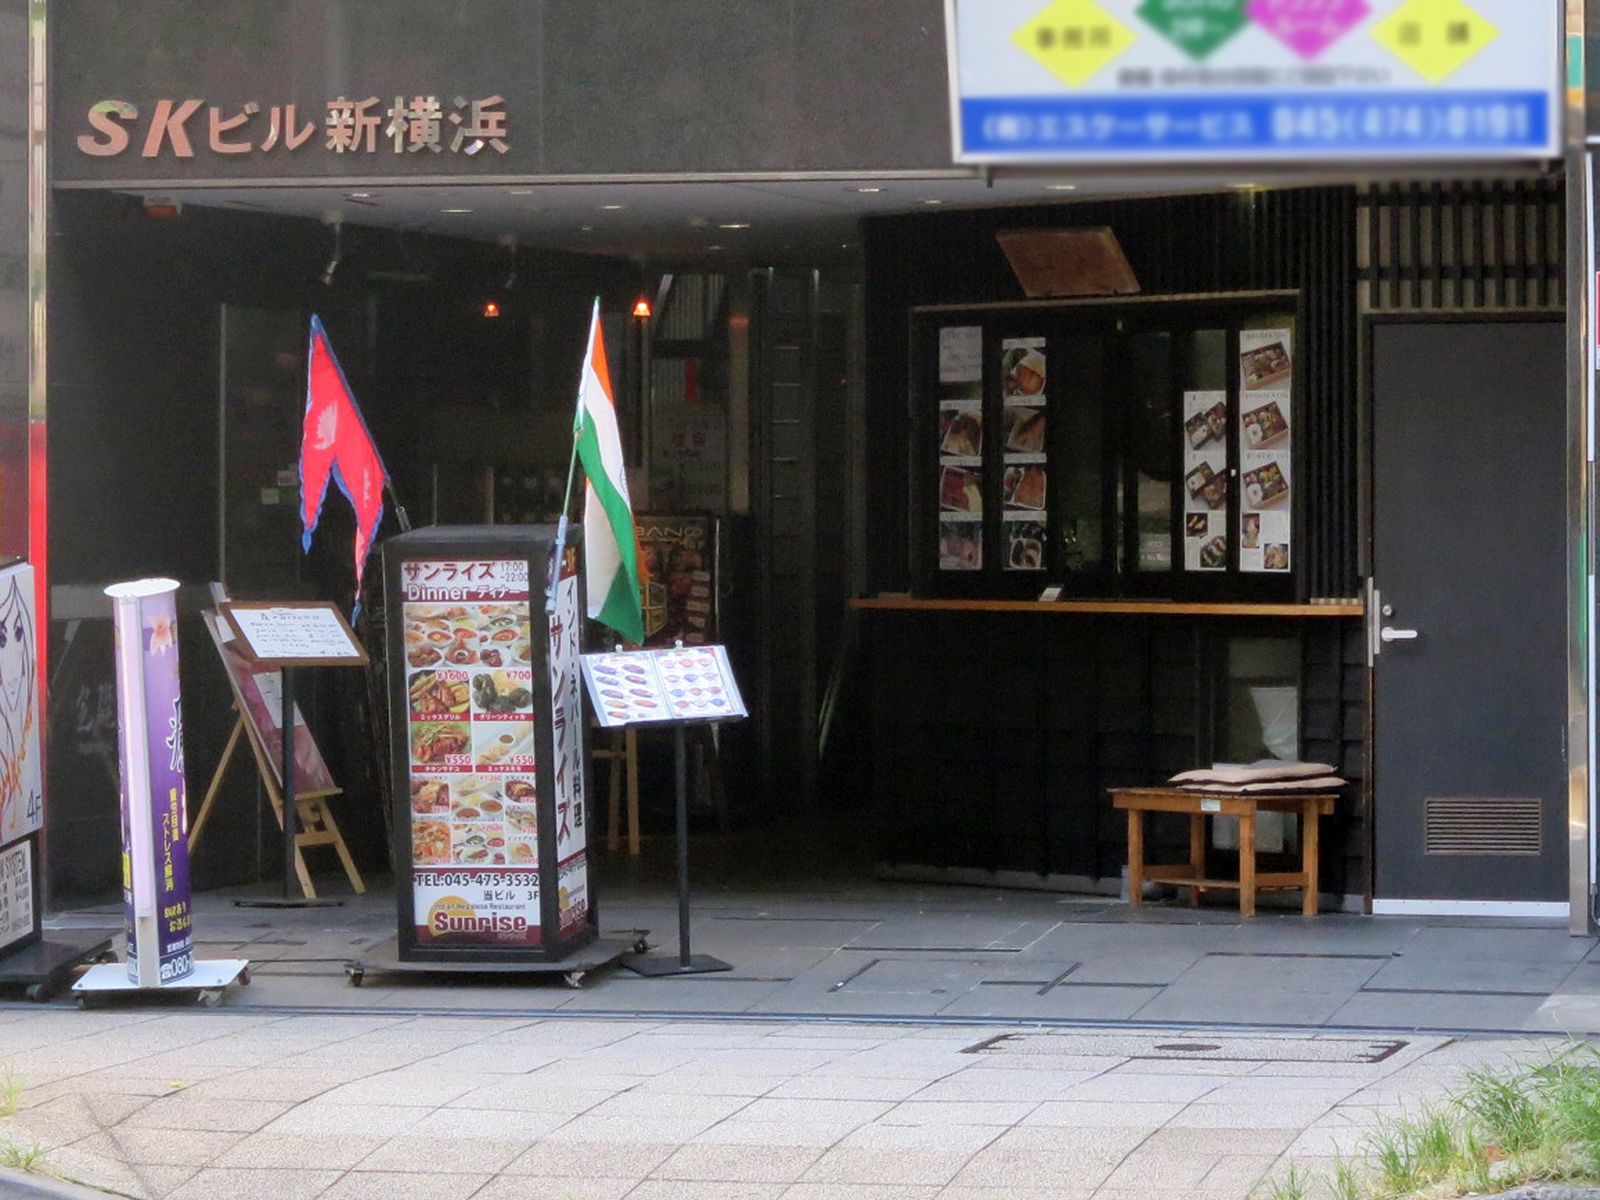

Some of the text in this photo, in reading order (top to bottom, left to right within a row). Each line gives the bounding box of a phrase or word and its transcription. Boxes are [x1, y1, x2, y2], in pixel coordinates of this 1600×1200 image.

[404, 561, 524, 582] サンライズ 17:00
[407, 584, 521, 601] Dinner ディナー
[506, 671, 531, 681] ¥700
[550, 614, 571, 847] サンライズ
[445, 754, 471, 764] ¥550
[509, 754, 534, 764] ¥550
[416, 873, 539, 887] TEL:045-475-3532
[483, 890, 539, 901] 当ビル 3F
[434, 911, 527, 932] Sunrise
